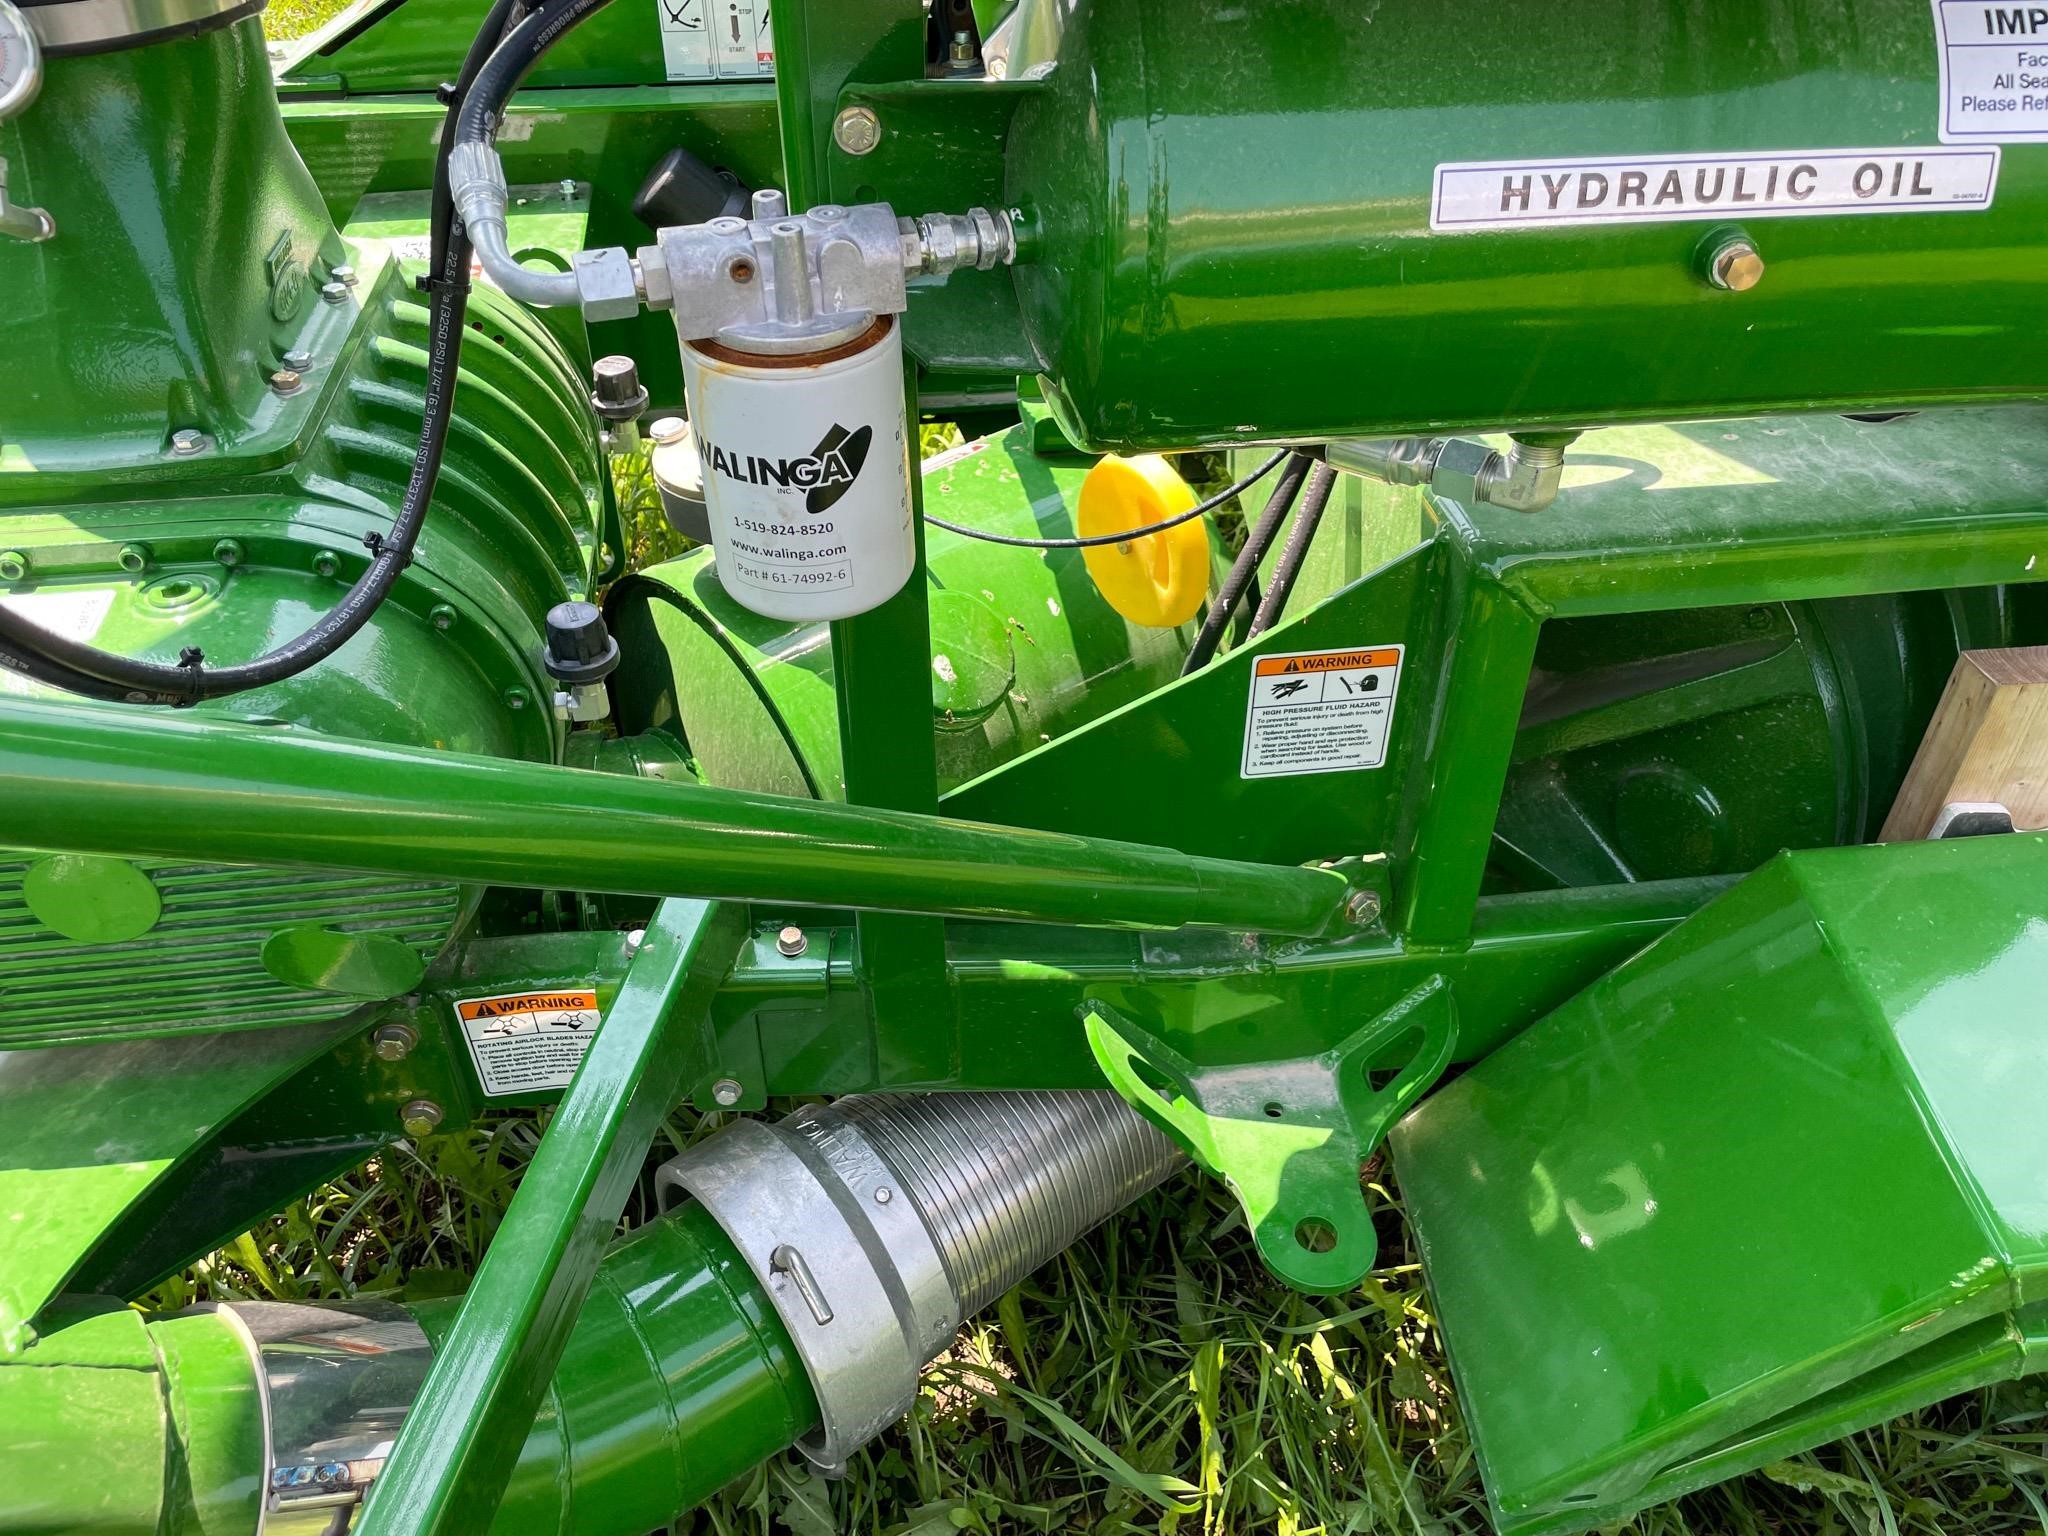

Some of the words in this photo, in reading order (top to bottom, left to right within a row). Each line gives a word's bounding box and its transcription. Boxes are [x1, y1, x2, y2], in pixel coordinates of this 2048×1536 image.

[2018, 52, 2048, 67] Fac
[1993, 74, 2014, 89] All
[1962, 96, 2017, 112] Please
[1500, 164, 1818, 212] HYDRAULIC
[1852, 161, 1934, 198] OIL
[416, 446, 429, 464] ISO
[694, 430, 853, 488] WALINGA
[405, 467, 424, 501] 11237
[400, 502, 414, 526] R17
[734, 516, 834, 536] 1-519-824-8520
[730, 538, 847, 561] www.walinga.com
[737, 562, 760, 580] Part
[762, 571, 769, 581] #
[772, 569, 846, 584] 61-74992-6
[349, 591, 367, 608] ISO
[326, 608, 354, 632] 18752
[1302, 654, 1372, 669] WARNING
[1284, 706, 1324, 714] PRESSURE
[496, 997, 585, 1012] WARNING
[477, 1040, 513, 1049] ROTATING
